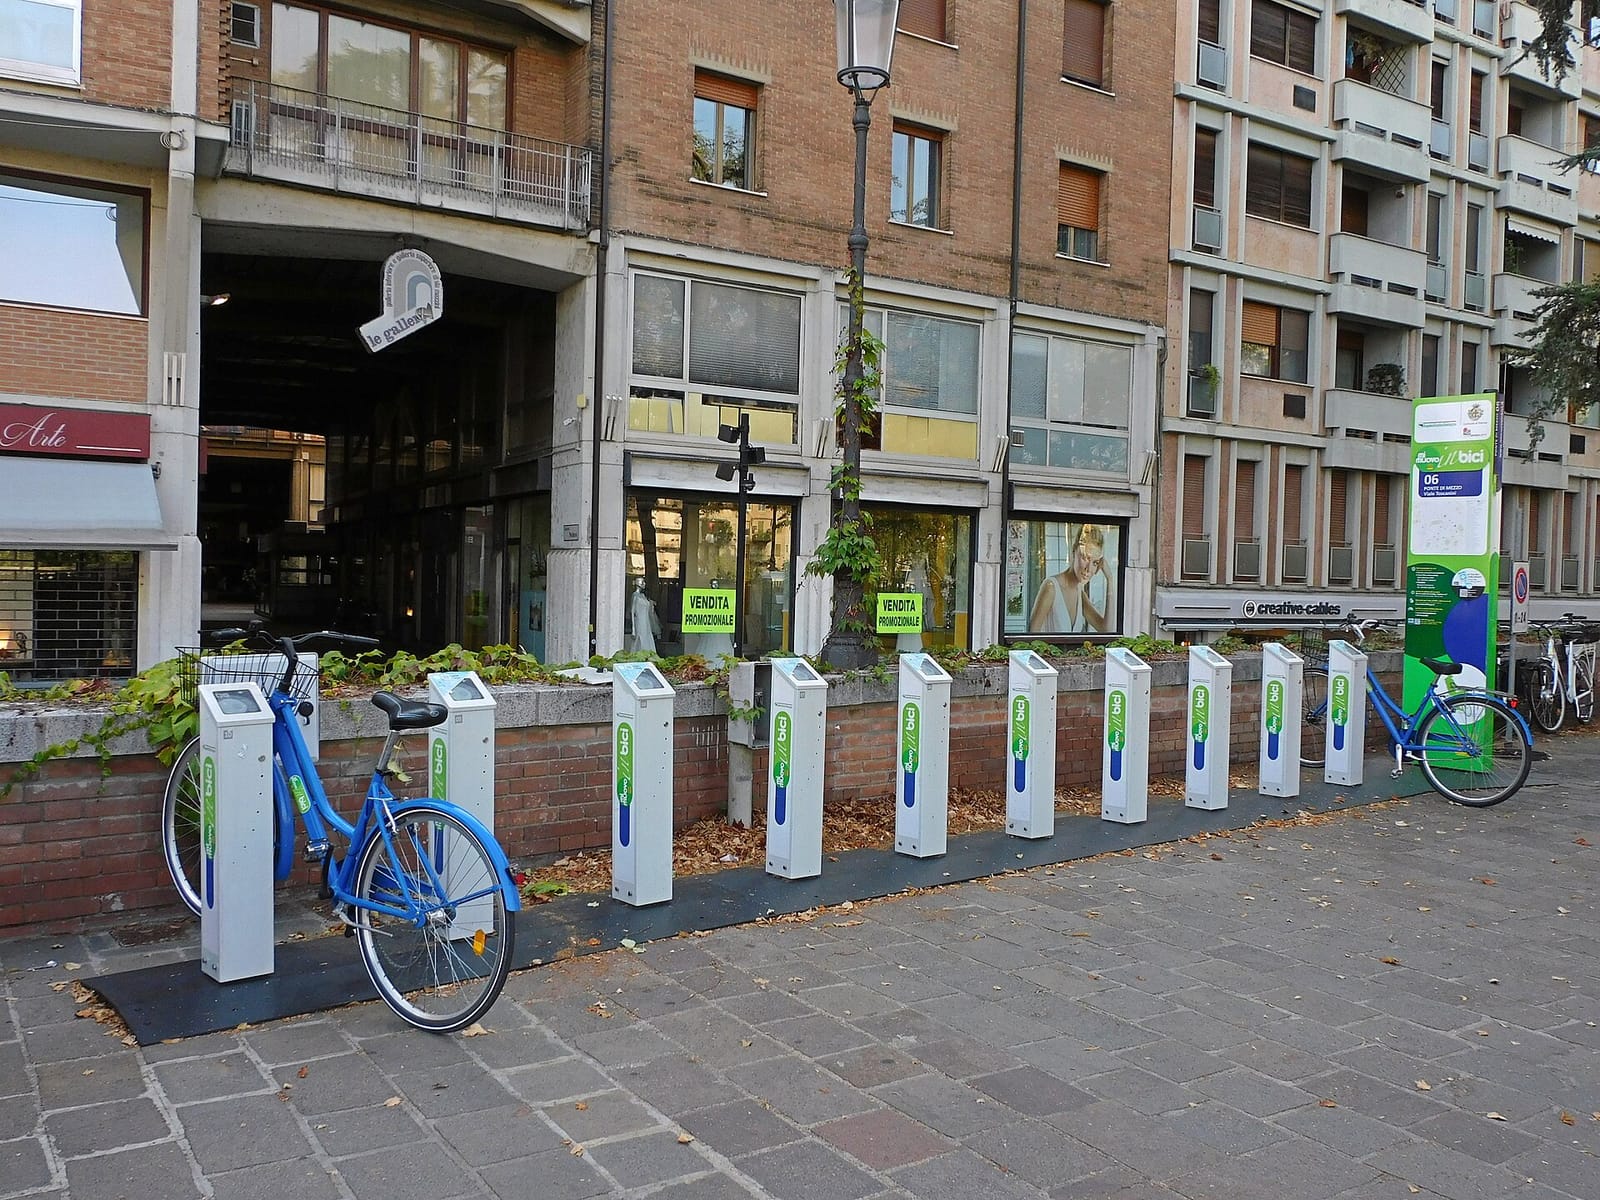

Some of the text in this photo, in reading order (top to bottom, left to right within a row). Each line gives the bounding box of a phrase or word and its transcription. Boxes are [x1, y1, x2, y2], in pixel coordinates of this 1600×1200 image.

[366, 334, 382, 348] le
[0, 412, 67, 447] Arte
[1458, 450, 1484, 464] bici
[1424, 474, 1439, 485] 06
[690, 596, 729, 609] VENDITA
[883, 600, 916, 611] VENDITA
[1258, 602, 1340, 614] creative-cables
[685, 614, 734, 626] PROMOZIONALE
[878, 616, 919, 626] PROMOZIONALE
[1270, 684, 1279, 702] bici
[1335, 679, 1344, 695] bici
[1112, 695, 1121, 715] bici
[1195, 689, 1205, 708] bici
[1015, 700, 1024, 721] bici
[906, 707, 915, 731] bici
[778, 716, 787, 741] bici
[620, 728, 628, 756] bici
